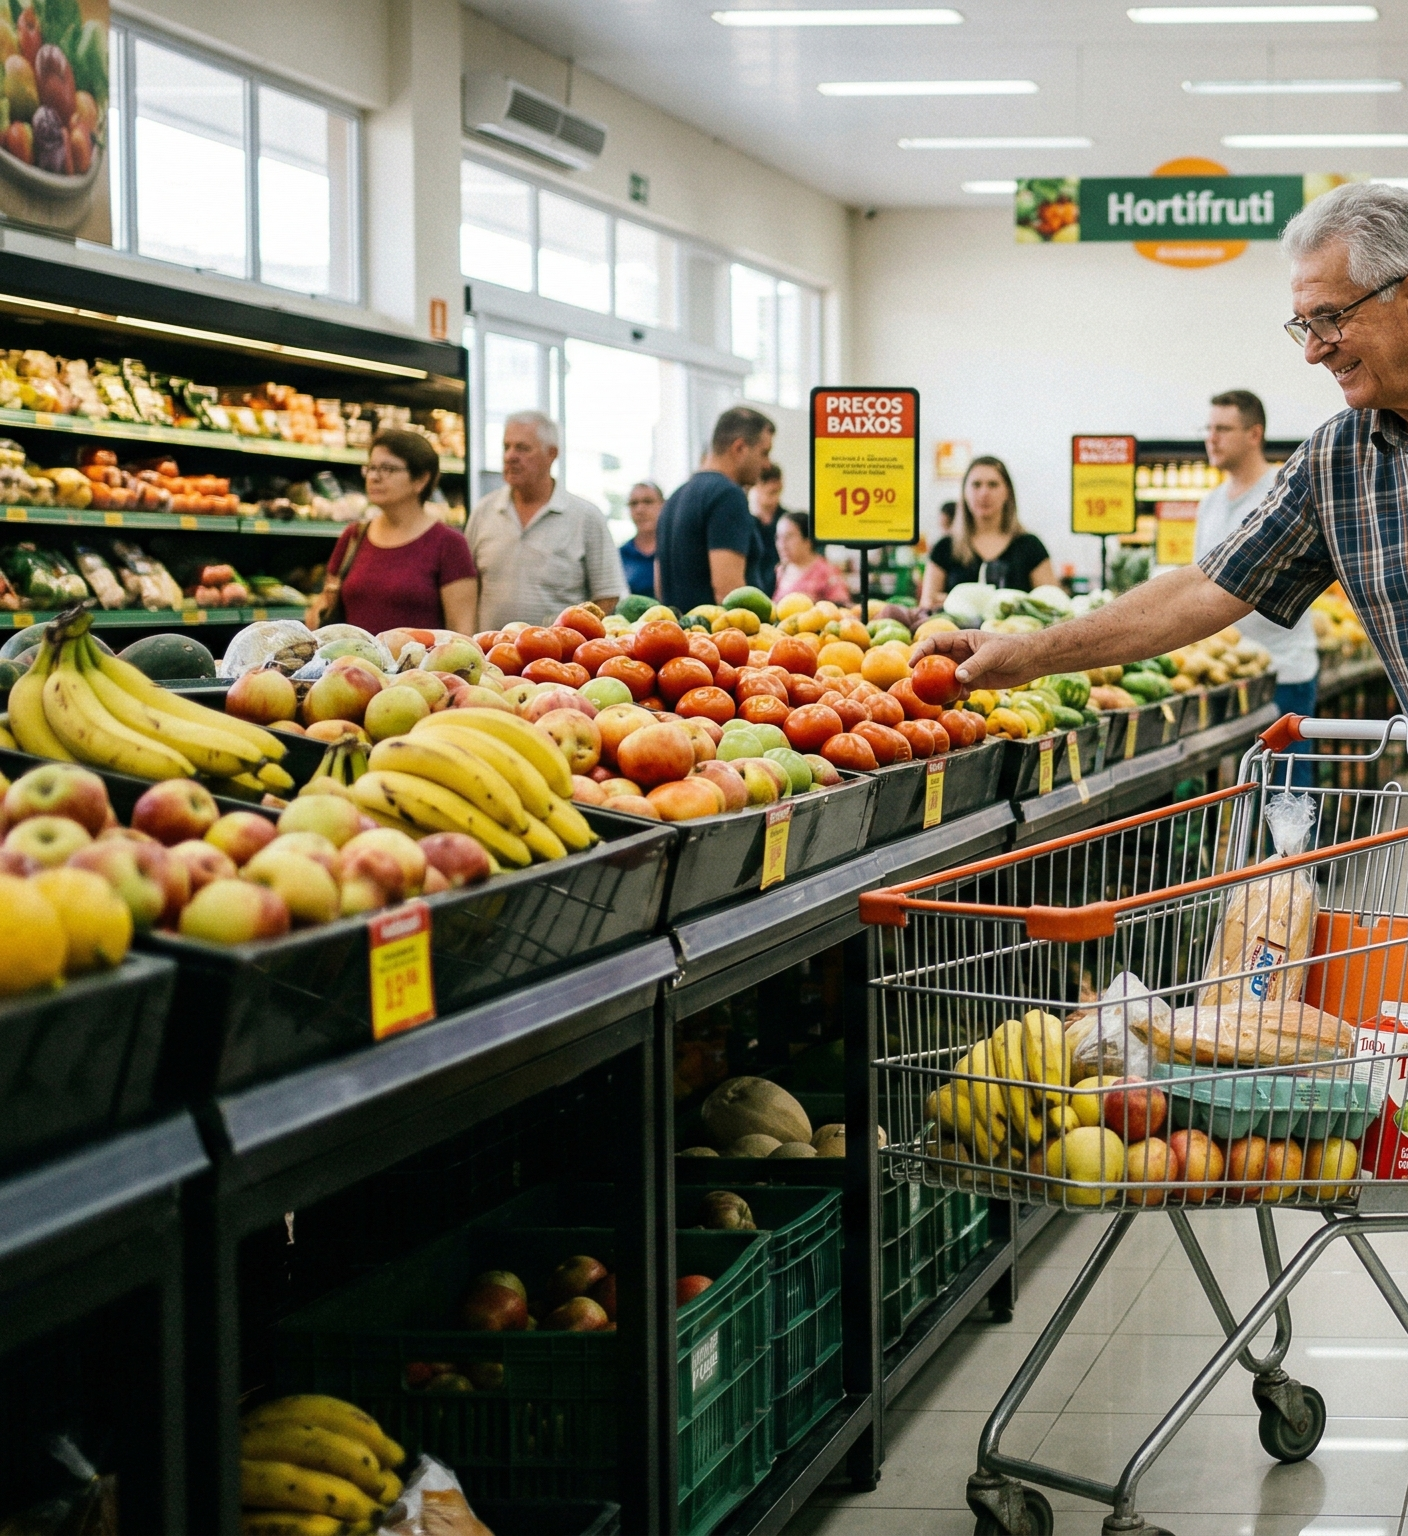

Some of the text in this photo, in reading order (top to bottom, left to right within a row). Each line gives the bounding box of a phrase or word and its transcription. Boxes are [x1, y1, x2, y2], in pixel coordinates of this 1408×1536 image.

[1108, 190, 1274, 226] Hortifruti
[826, 396, 903, 416] PREÇOS
[827, 416, 902, 434] BAIXOS
[834, 487, 896, 516] 19 90
